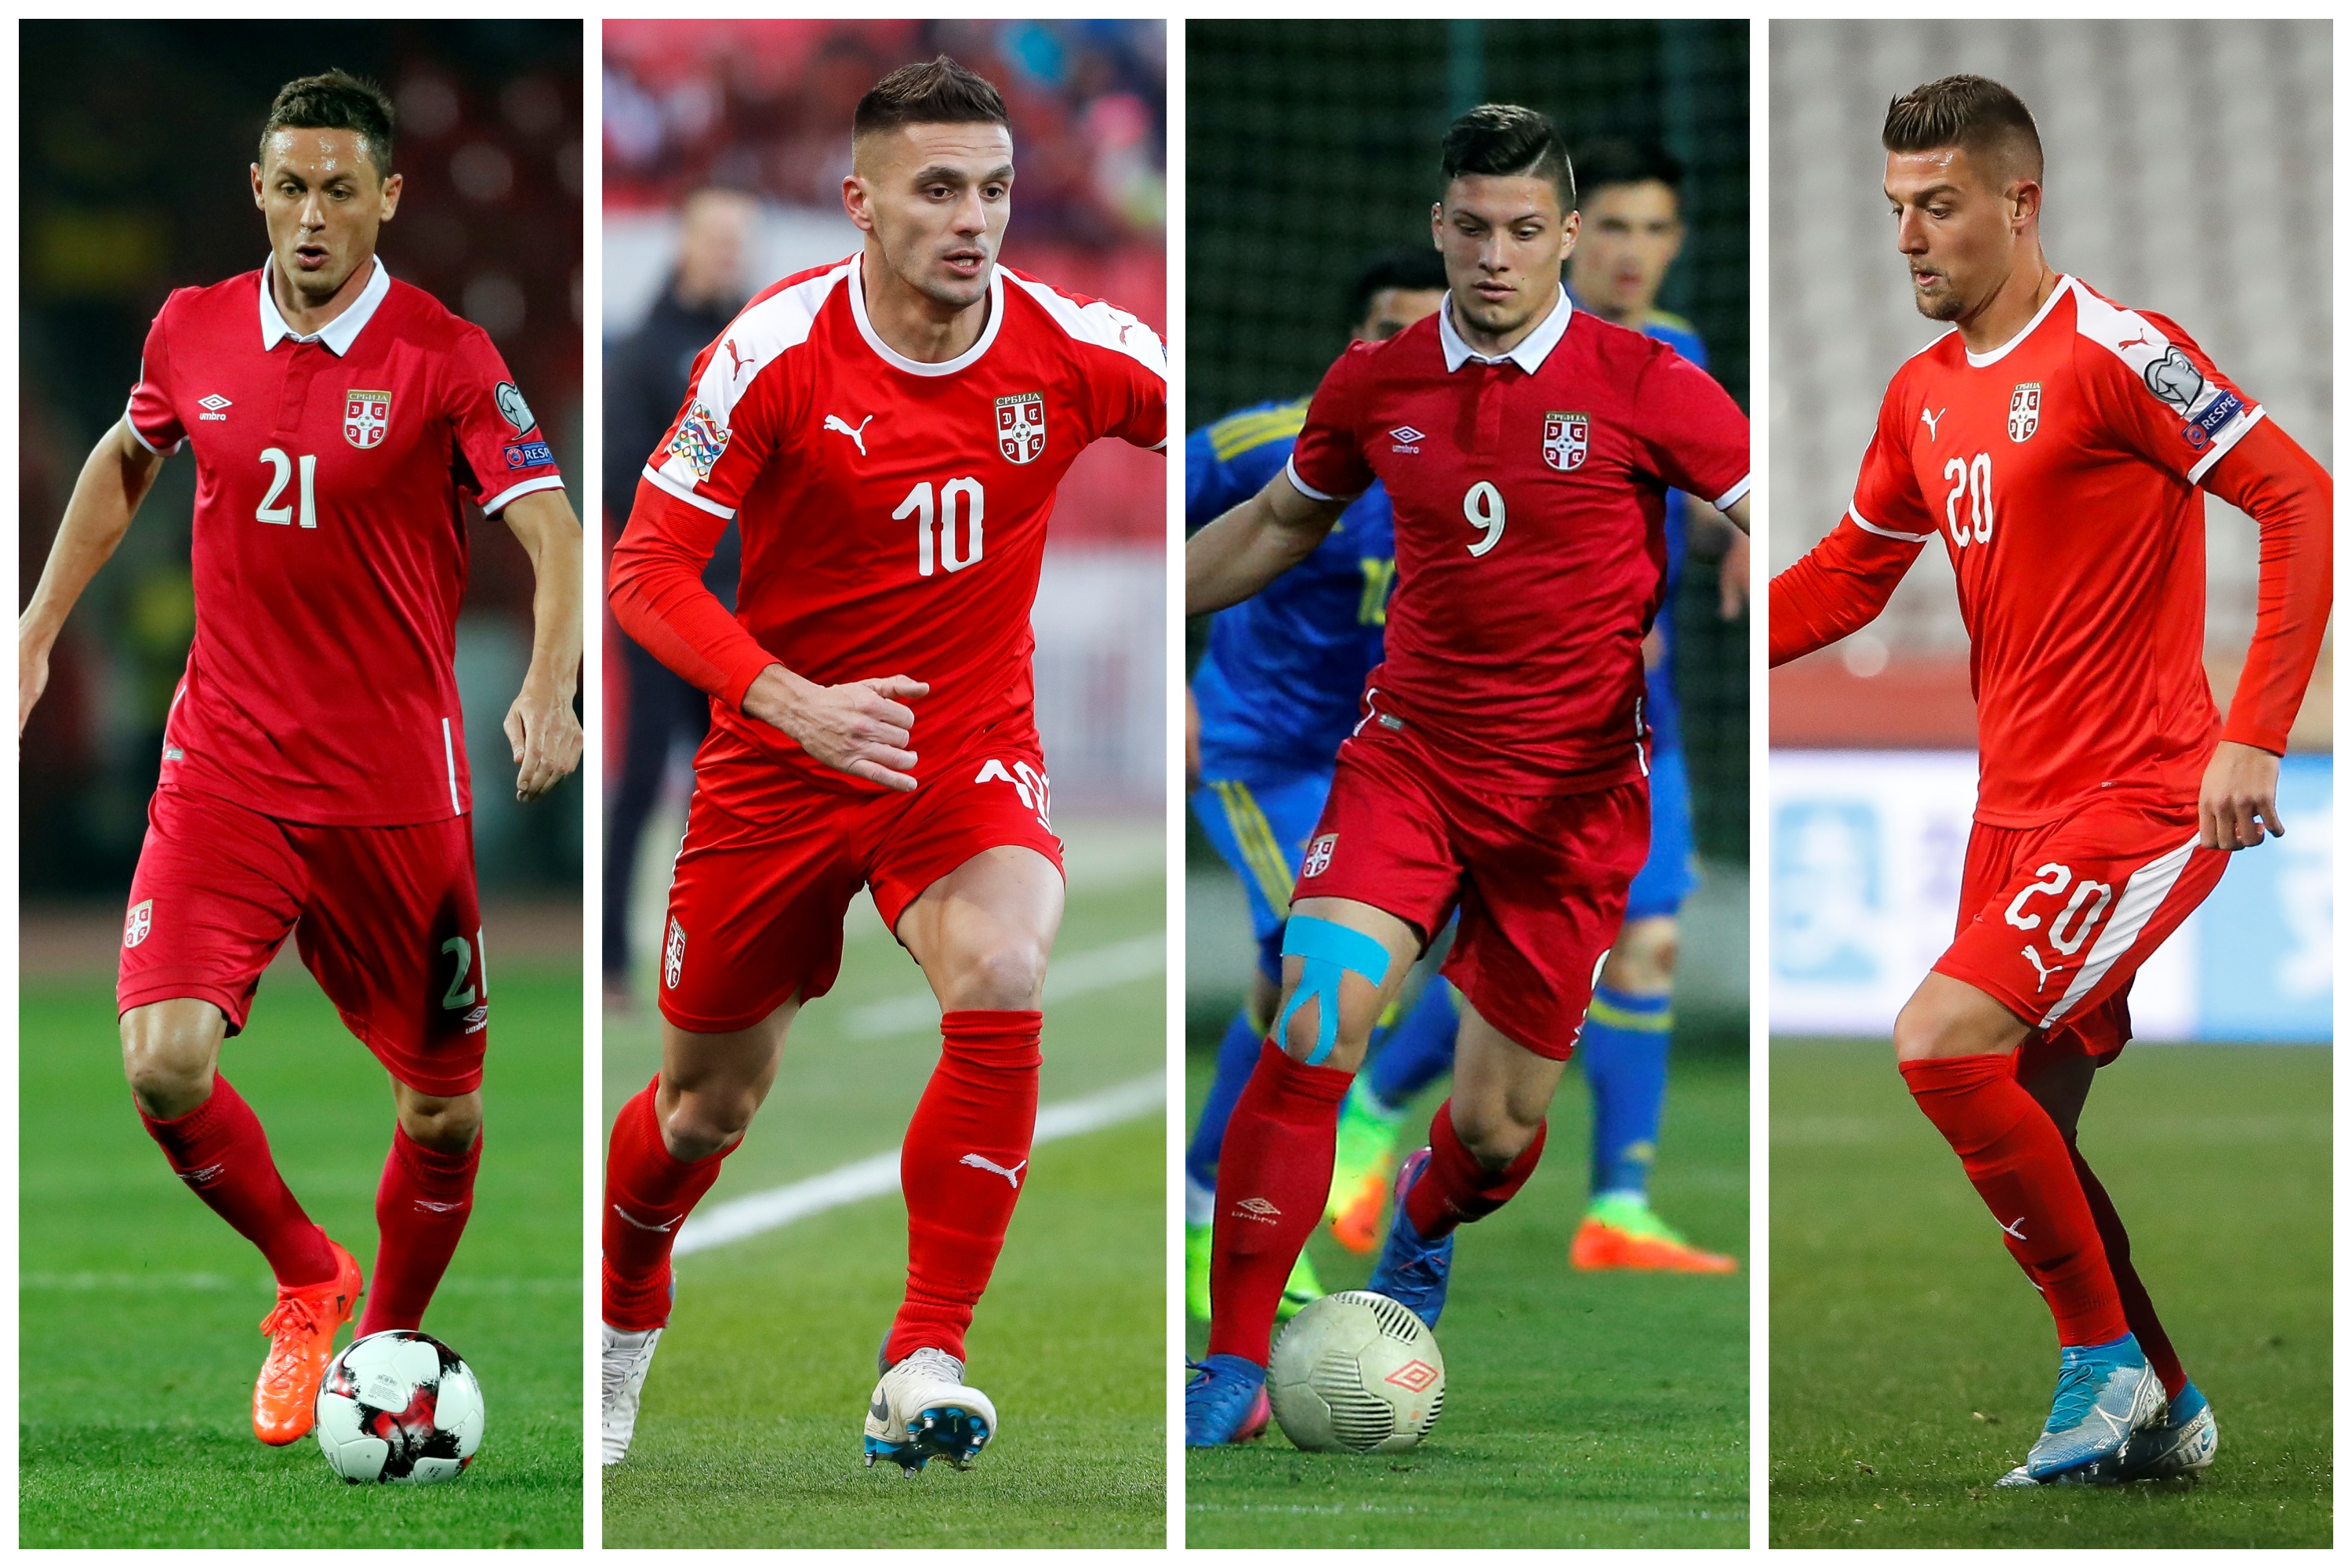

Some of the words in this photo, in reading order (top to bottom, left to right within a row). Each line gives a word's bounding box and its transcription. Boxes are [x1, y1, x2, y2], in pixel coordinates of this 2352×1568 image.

[199, 412, 227, 421] umbro
[349, 392, 388, 401] СРБИЈА
[996, 393, 1041, 405] СРБИЈА
[2015, 382, 2042, 390] СРБИЈА
[256, 447, 317, 528] 21
[1392, 445, 1420, 454] umbro
[891, 476, 984, 576] 10
[1463, 480, 1506, 557] 9
[1944, 452, 1994, 548] 20
[2004, 862, 2111, 956] 20
[441, 924, 488, 1010] 21
